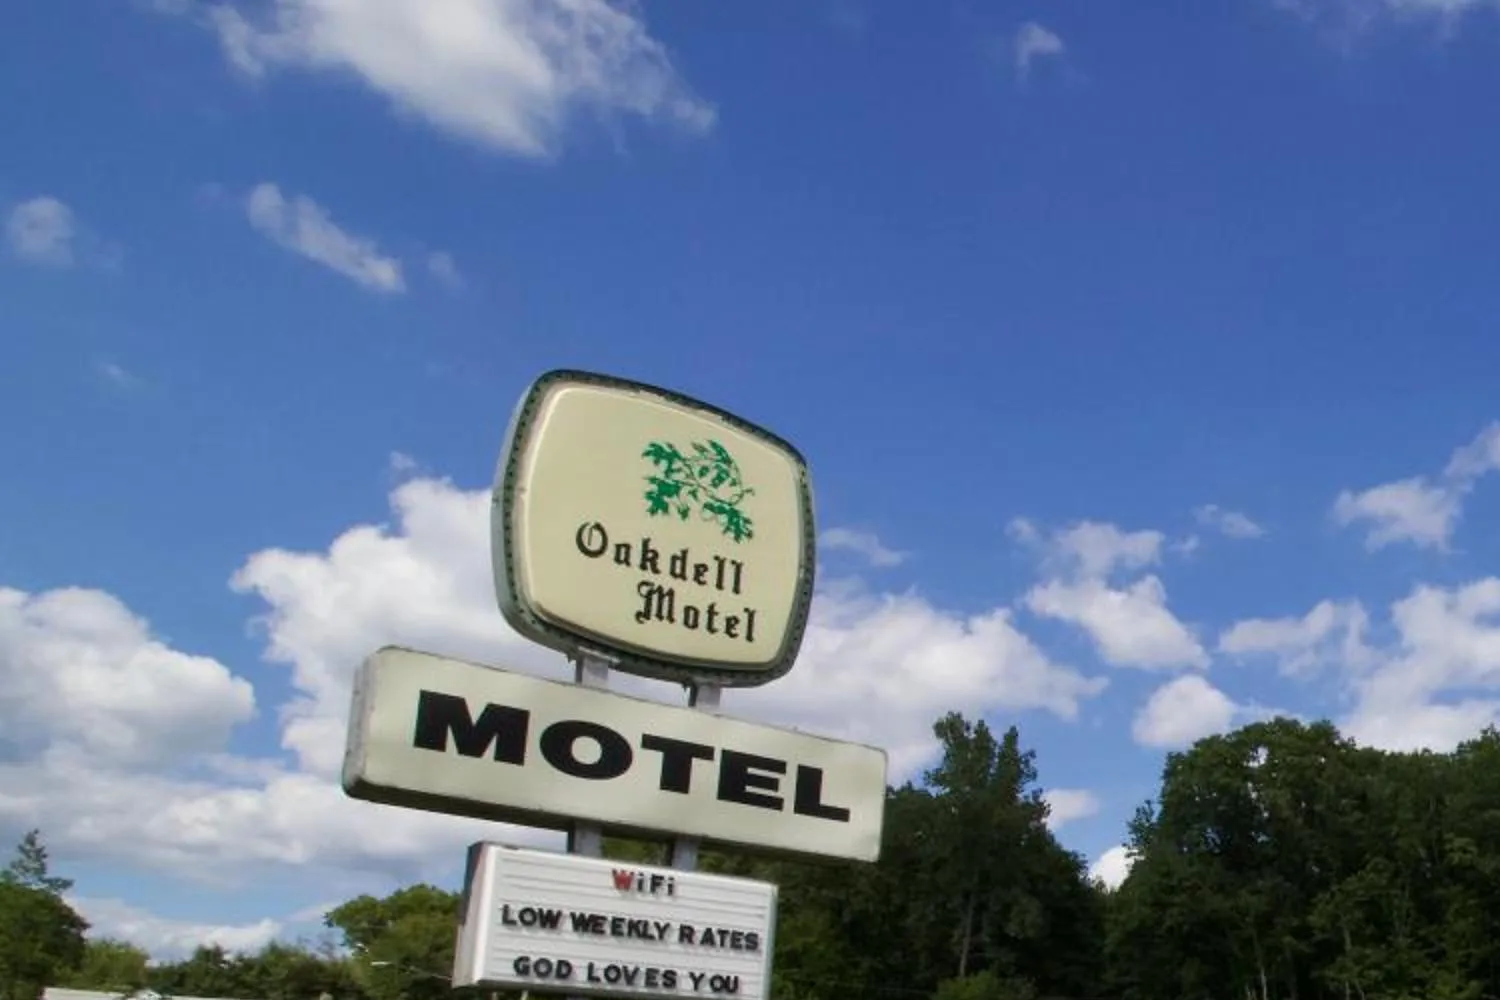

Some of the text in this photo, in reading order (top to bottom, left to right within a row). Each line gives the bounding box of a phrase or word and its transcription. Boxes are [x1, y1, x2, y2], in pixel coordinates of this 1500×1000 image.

[575, 521, 745, 596] Oakdell
[634, 580, 757, 643] Motel
[413, 689, 851, 822] MOTEL
[611, 868, 675, 896] WiFi
[501, 904, 761, 951] LOW WEEKLY RATES
[513, 955, 740, 994] GOD LOVES YOU
